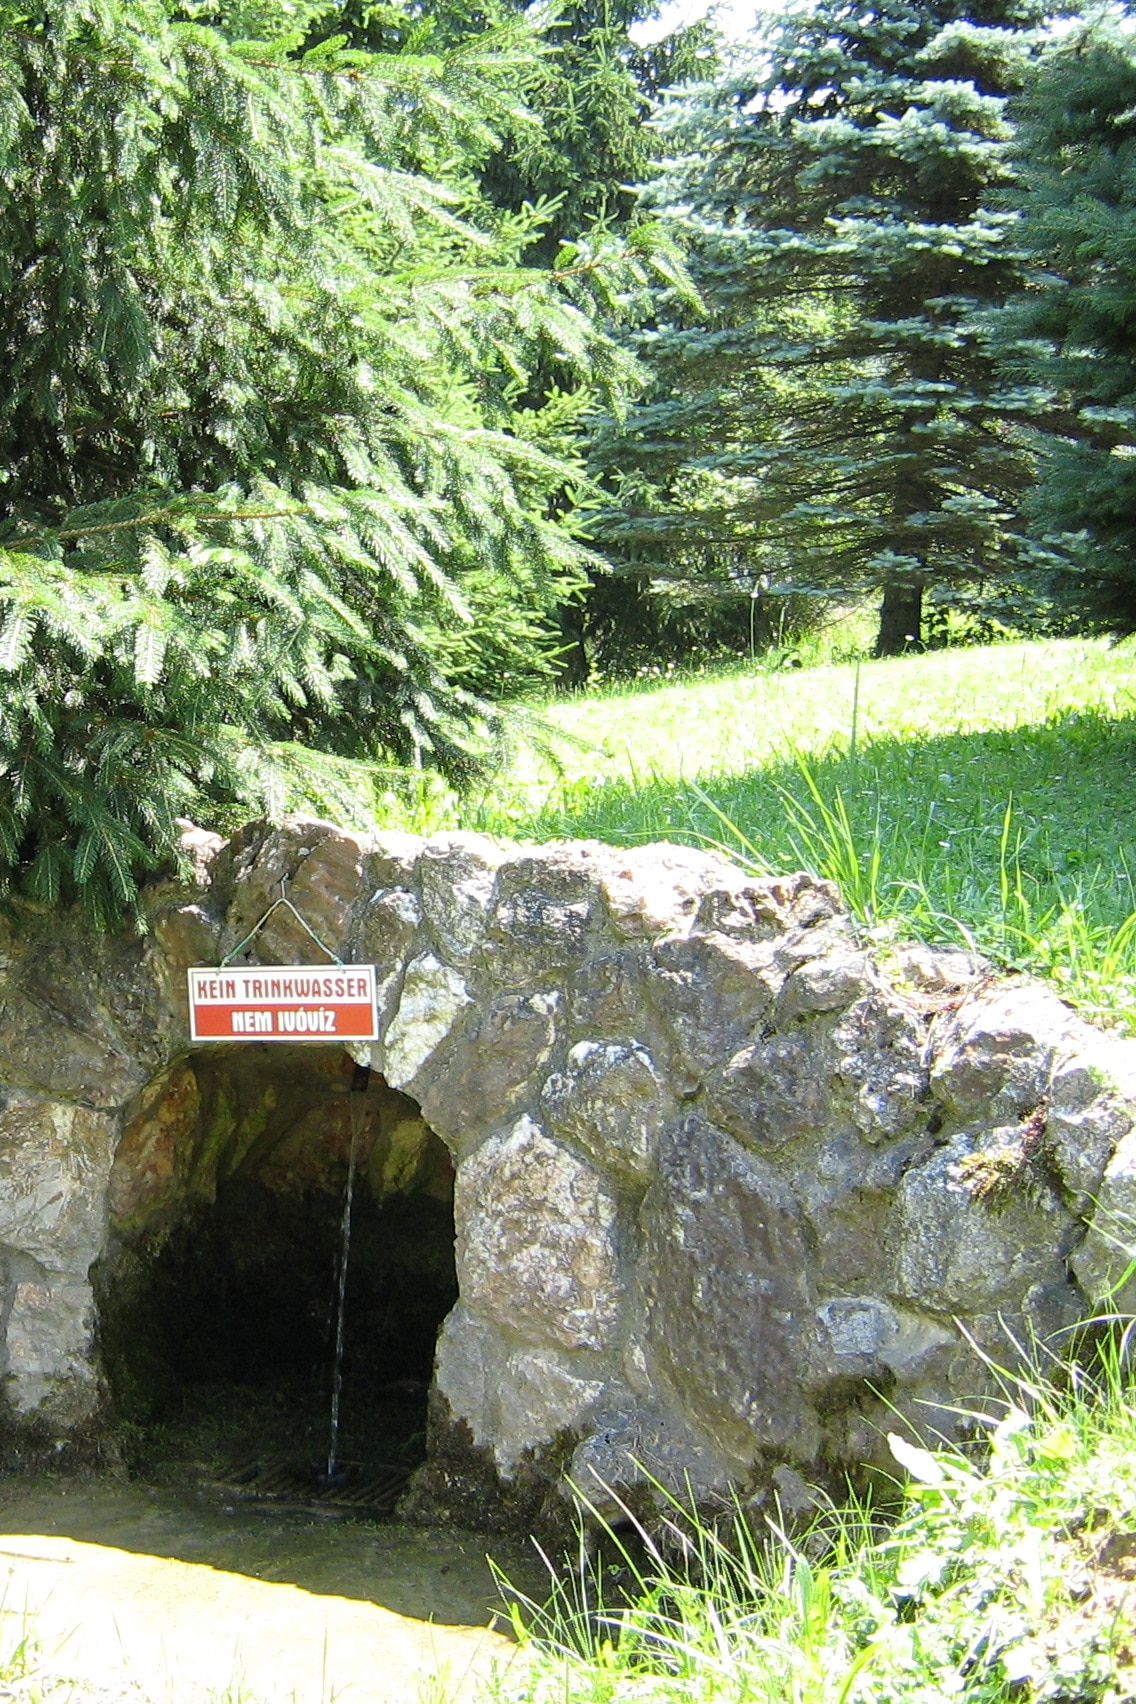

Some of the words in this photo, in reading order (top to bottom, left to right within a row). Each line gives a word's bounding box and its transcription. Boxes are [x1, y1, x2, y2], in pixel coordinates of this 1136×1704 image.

[197, 979, 236, 999] KEIN
[242, 977, 368, 999] TRINKWASSER
[231, 1011, 273, 1032] NEM
[277, 1006, 336, 1032] IVÓVÍZ
